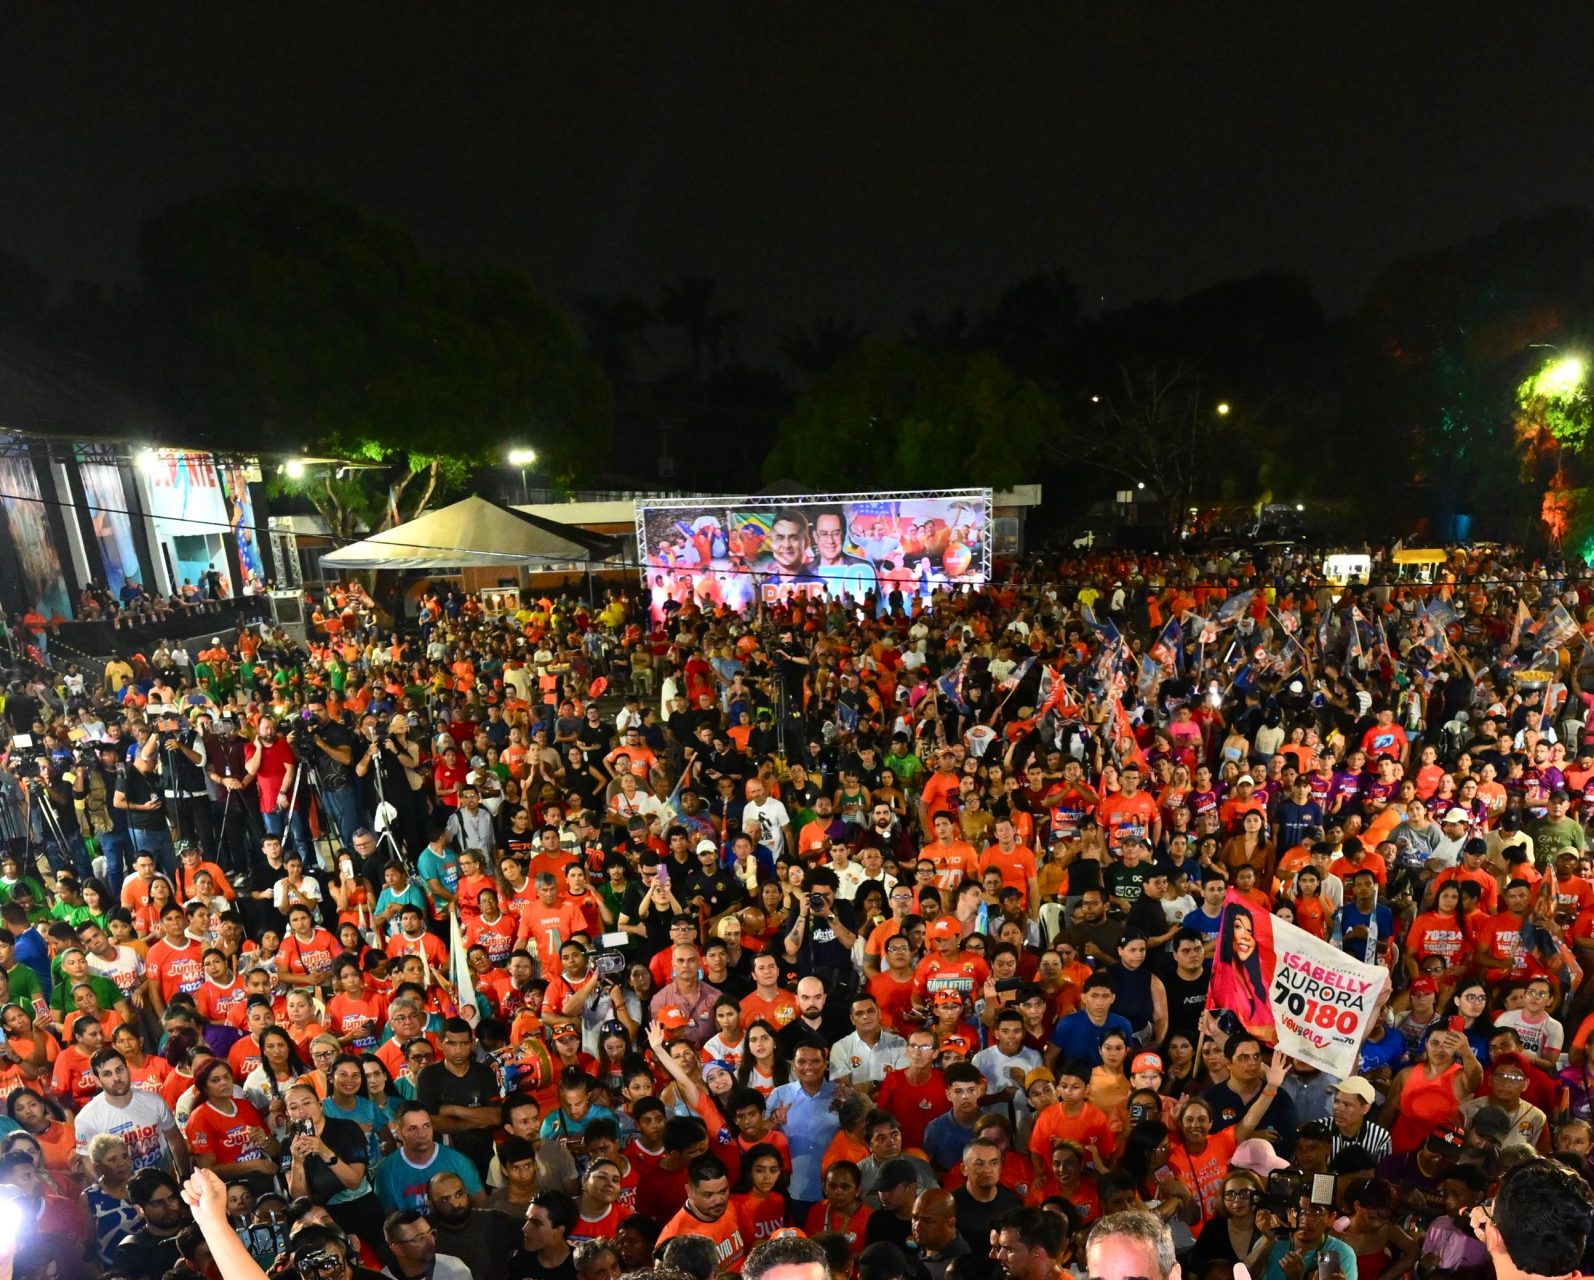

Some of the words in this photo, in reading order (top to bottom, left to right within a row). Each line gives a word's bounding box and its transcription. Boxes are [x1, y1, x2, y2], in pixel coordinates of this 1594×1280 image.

[585, 847, 605, 872] 70
[1132, 874, 1143, 883] OC
[167, 959, 204, 977] Júnio
[1283, 951, 1373, 994] ISABELLY
[179, 981, 202, 993] 7022
[1277, 966, 1364, 1012] AURORA
[1274, 981, 1359, 1035] 70180
